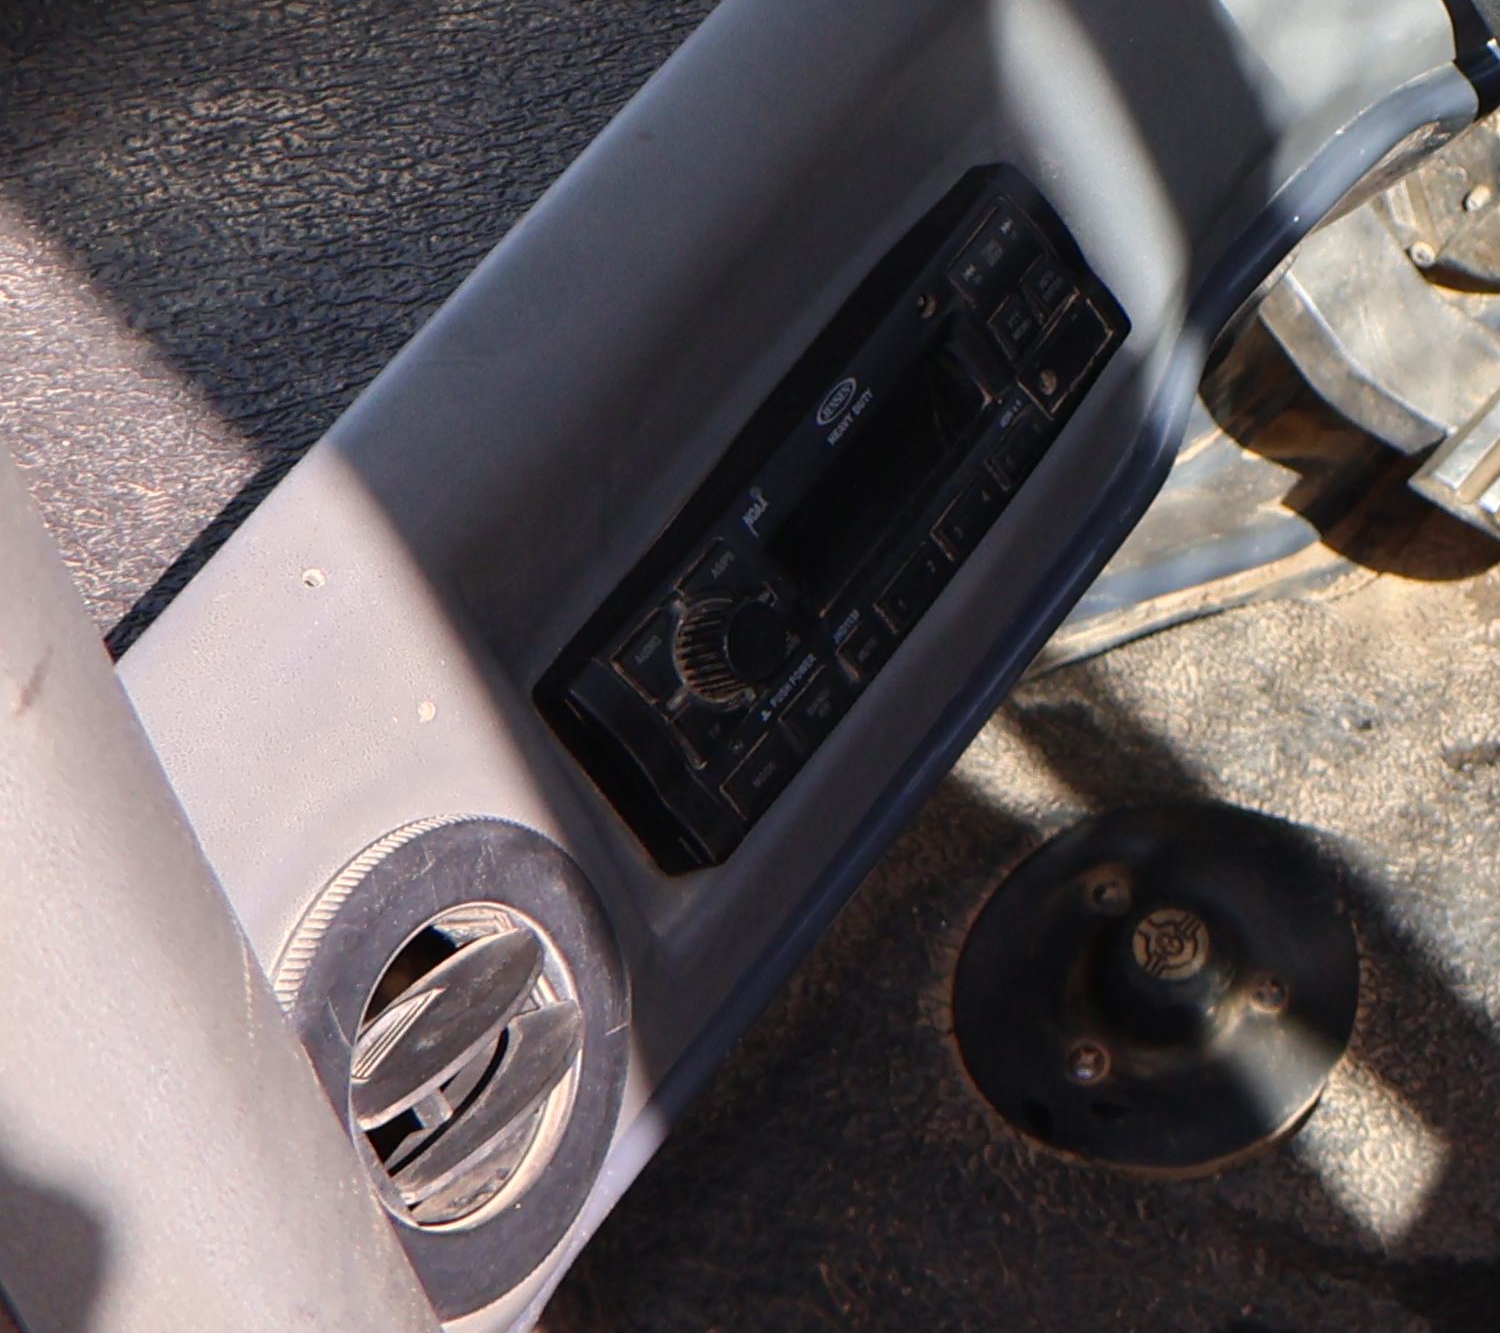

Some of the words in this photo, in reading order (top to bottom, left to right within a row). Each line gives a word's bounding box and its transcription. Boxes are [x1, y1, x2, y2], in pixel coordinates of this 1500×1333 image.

[822, 382, 855, 423] JENSEN
[826, 411, 855, 447] HEAVY
[852, 386, 875, 417] DUTY
[634, 634, 663, 666] AUDIO
[769, 680, 793, 709] PUSH
[788, 651, 818, 686] POWER
